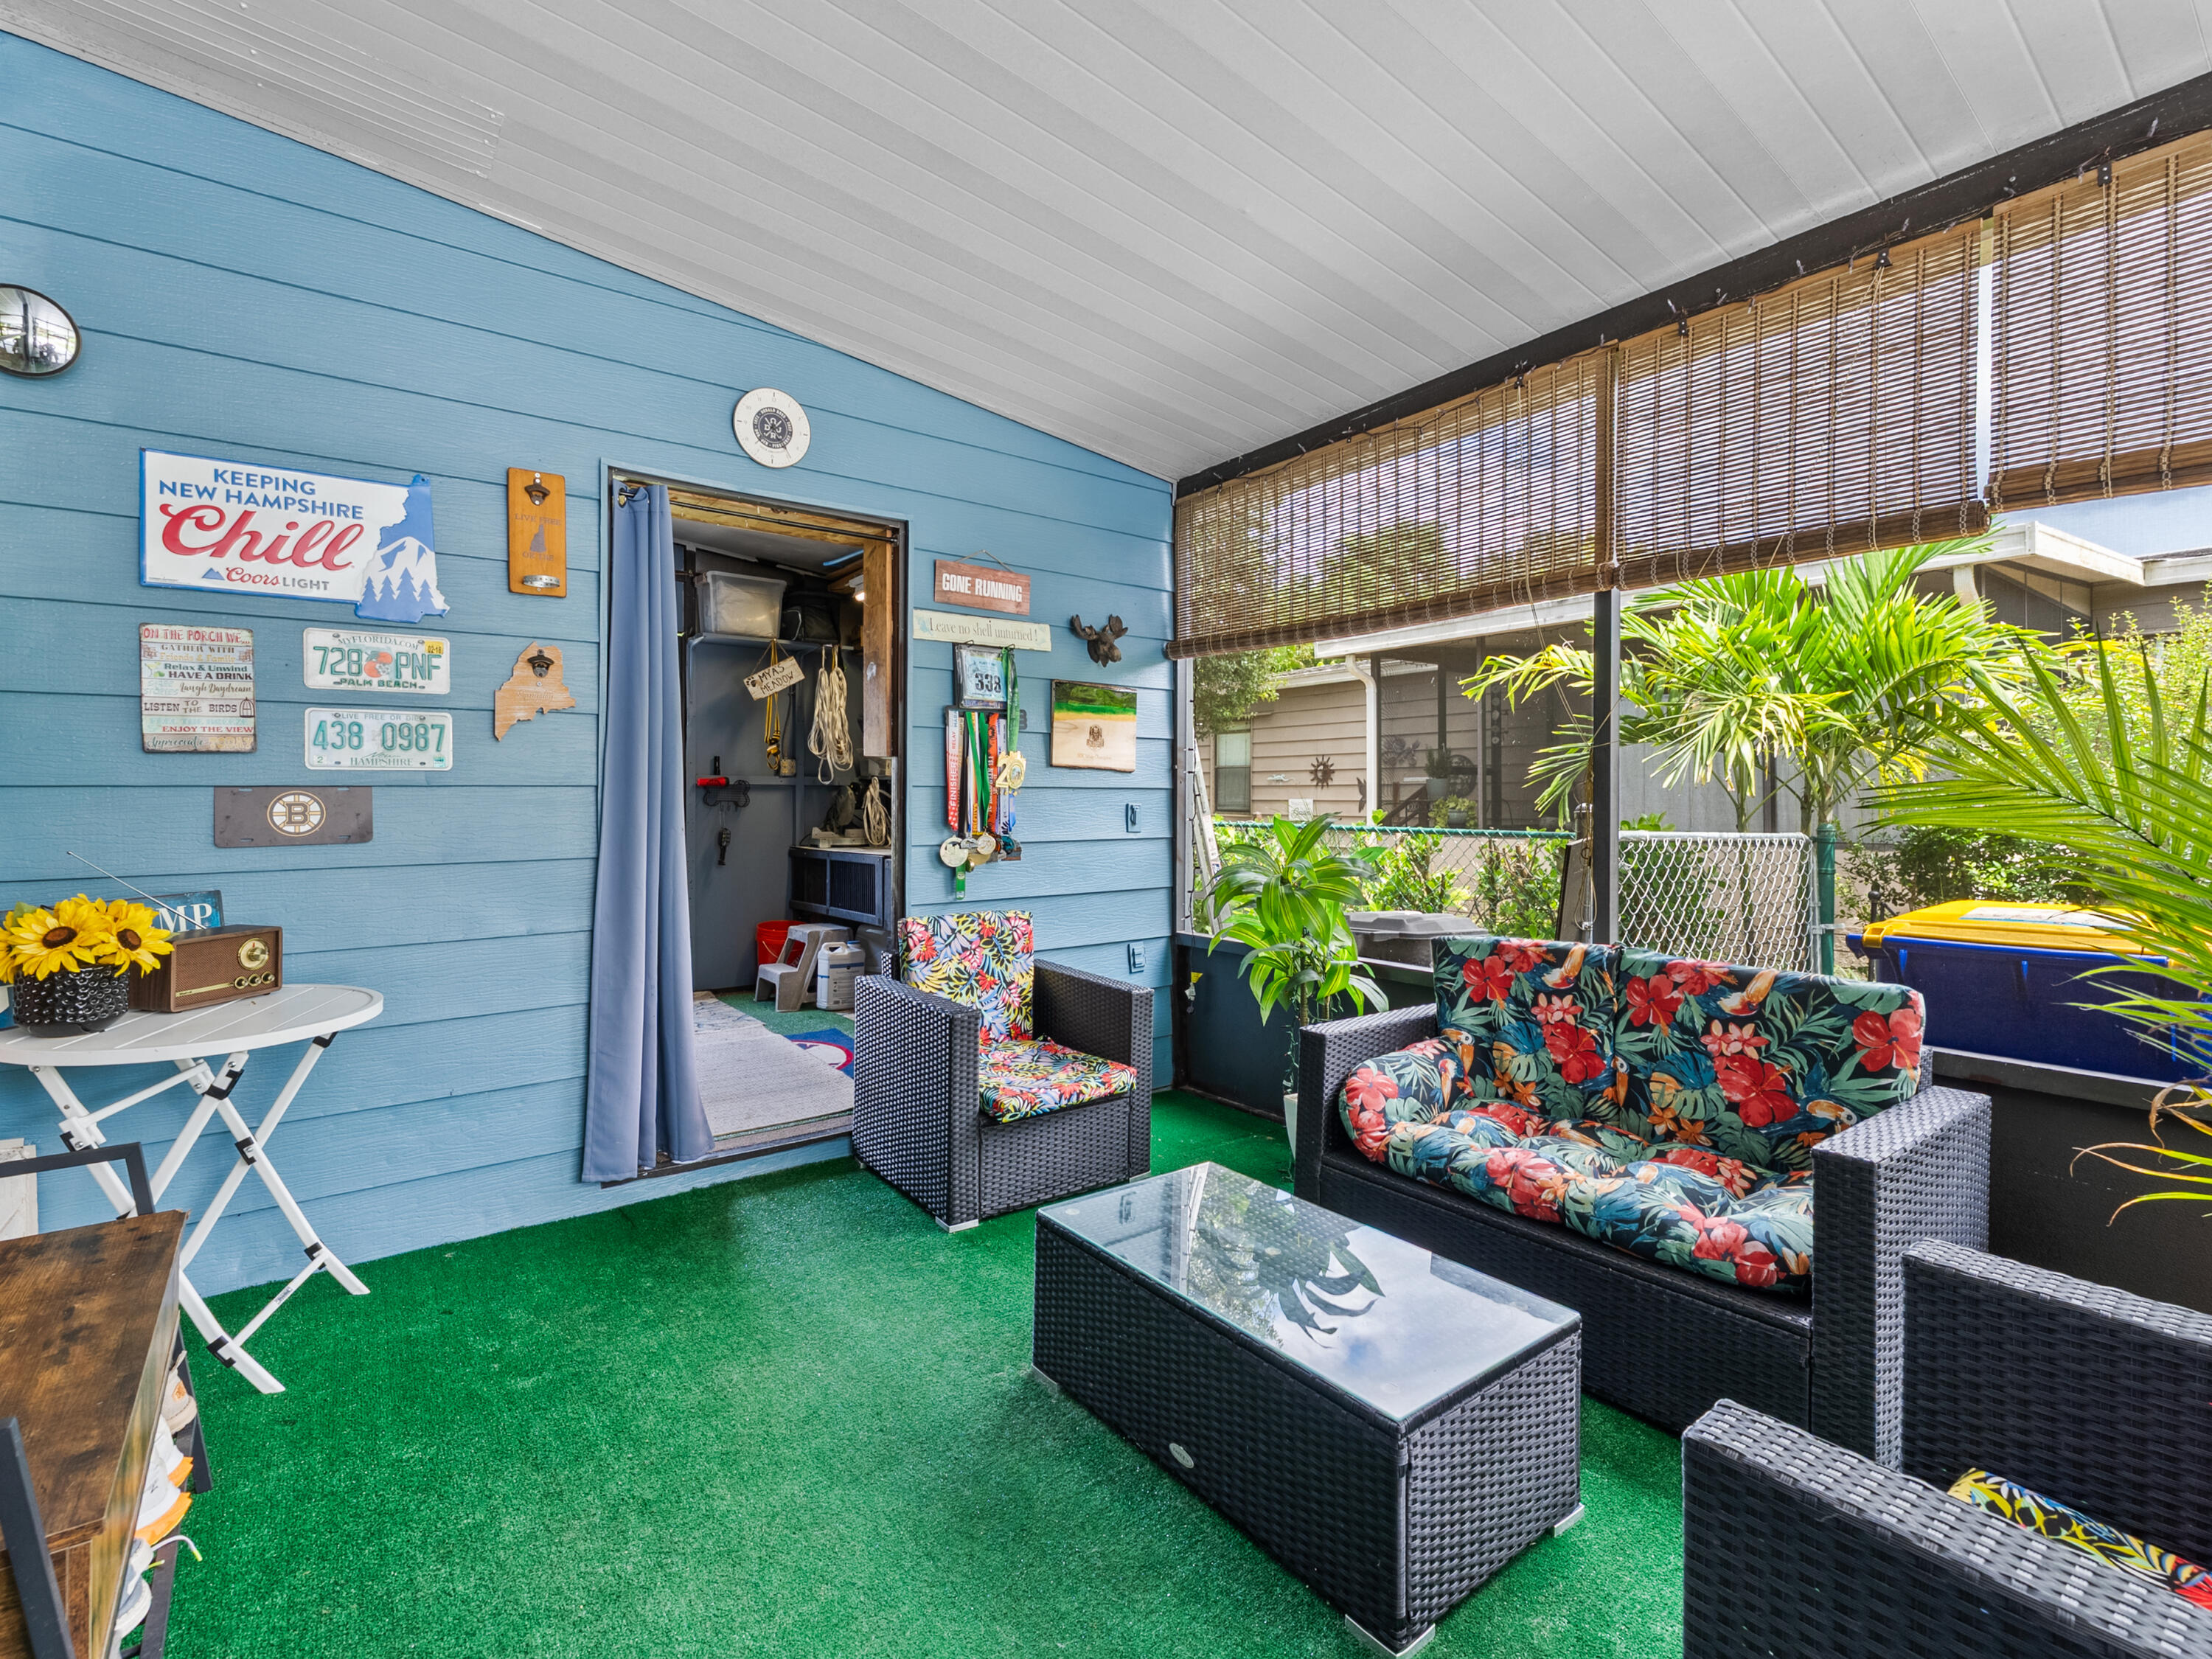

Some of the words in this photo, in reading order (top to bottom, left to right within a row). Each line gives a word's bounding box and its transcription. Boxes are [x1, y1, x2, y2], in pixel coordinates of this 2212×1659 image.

[213, 468, 316, 496] KEEPING
[159, 480, 217, 502] NEW
[226, 490, 364, 521] HAMPSHIRE
[159, 503, 364, 571] Chill
[226, 567, 279, 585] Coors
[282, 577, 330, 591] LIGHT
[942, 573, 972, 593] GONE
[975, 579, 1023, 602] RUNNING
[142, 627, 159, 639] ON
[164, 629, 184, 640] THE
[187, 630, 223, 643] PORCH
[929, 617, 956, 634] Leave
[959, 622, 971, 635] no
[972, 622, 993, 638] shell
[159, 652, 194, 661] Friends
[206, 654, 237, 664] Family
[161, 644, 204, 653] GATHER
[209, 646, 235, 654] WITH
[164, 663, 195, 671] Relax
[313, 646, 363, 677] 728
[395, 652, 442, 681] PNF
[168, 671, 202, 679] HAVE
[204, 672, 213, 680] A
[216, 672, 254, 681] DRINK
[340, 678, 372, 687] PALM
[378, 679, 417, 689] BEACH
[760, 671, 794, 695] MEADOW
[975, 672, 1002, 693] 338
[180, 682, 207, 696] Laugh
[209, 683, 252, 697] Daydream
[143, 702, 180, 712] LISTEN
[209, 703, 237, 712] BIRDS
[313, 720, 364, 751] 438
[381, 722, 446, 752] 0987
[349, 757, 414, 767] HAMPSHIRE
[950, 761, 958, 807] FINISHER
[285, 801, 310, 826] B
